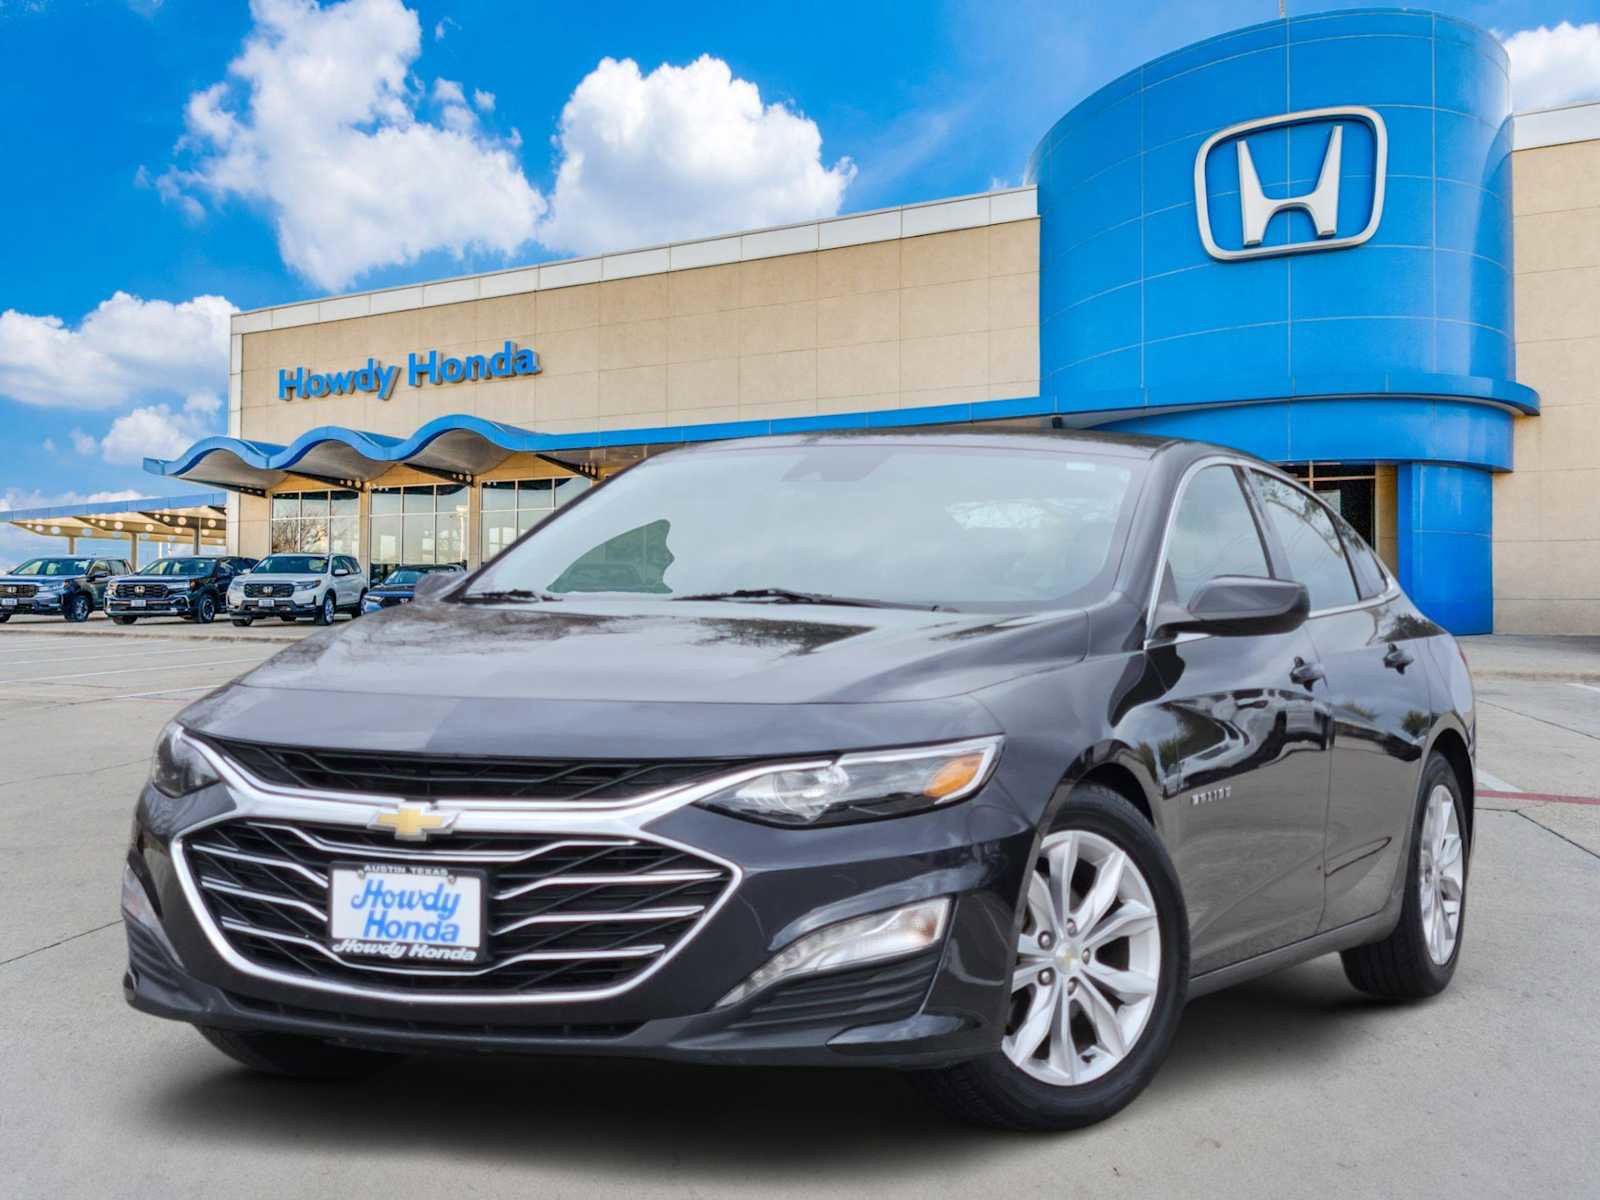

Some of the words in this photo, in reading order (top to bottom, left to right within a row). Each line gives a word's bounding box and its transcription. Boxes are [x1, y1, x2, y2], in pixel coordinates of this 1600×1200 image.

[278, 358, 401, 401] Howdy
[408, 340, 542, 387] Honda
[363, 865, 406, 875] AUSTIN
[411, 867, 449, 877] TEXAS
[351, 879, 461, 920] Howdy
[363, 910, 461, 943] Honda
[333, 938, 407, 959] Howdy
[408, 945, 477, 962] Honda
